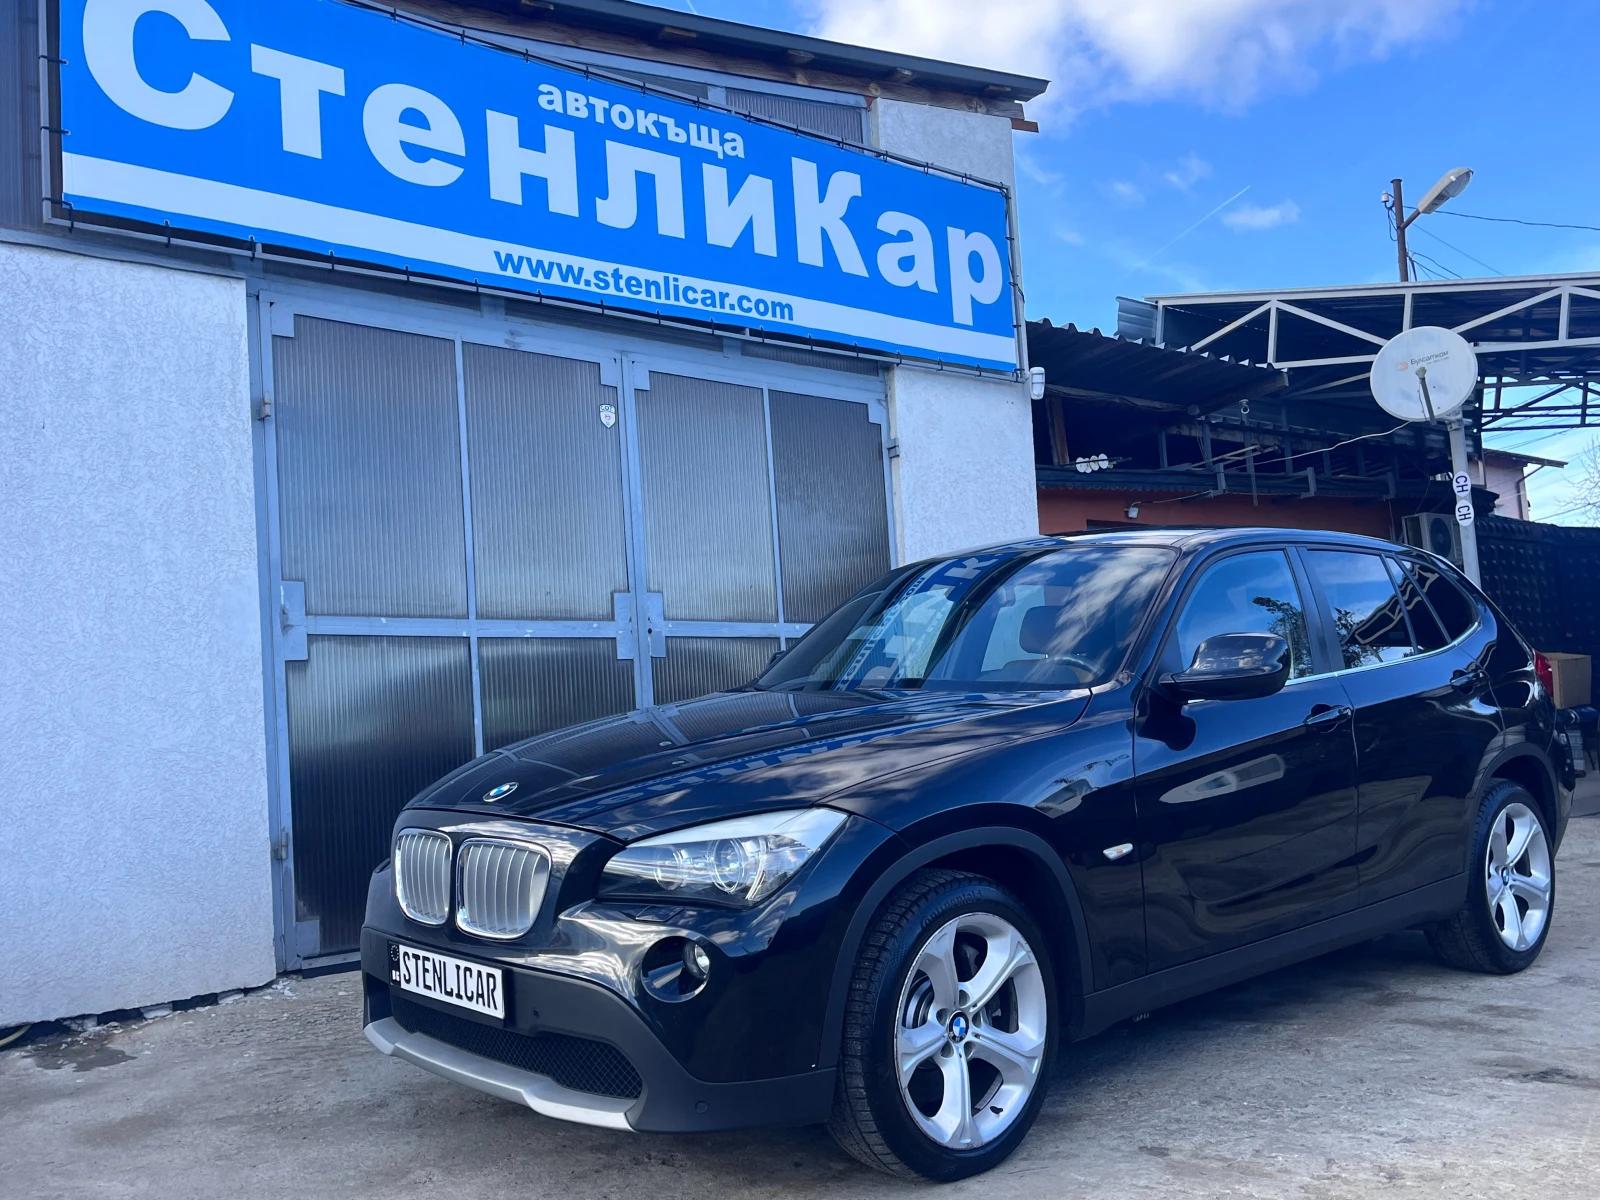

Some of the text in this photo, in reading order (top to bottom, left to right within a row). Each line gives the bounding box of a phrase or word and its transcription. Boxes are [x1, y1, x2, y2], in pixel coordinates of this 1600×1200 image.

[538, 84, 745, 159] автокъща
[83, 0, 1003, 326] СтенлиКар
[494, 251, 794, 322] www.stenlicar.com
[1410, 351, 1449, 365] Булсатком
[1455, 475, 1469, 493] CH
[1457, 505, 1472, 521] CH
[402, 951, 498, 1011] STENLICAR
